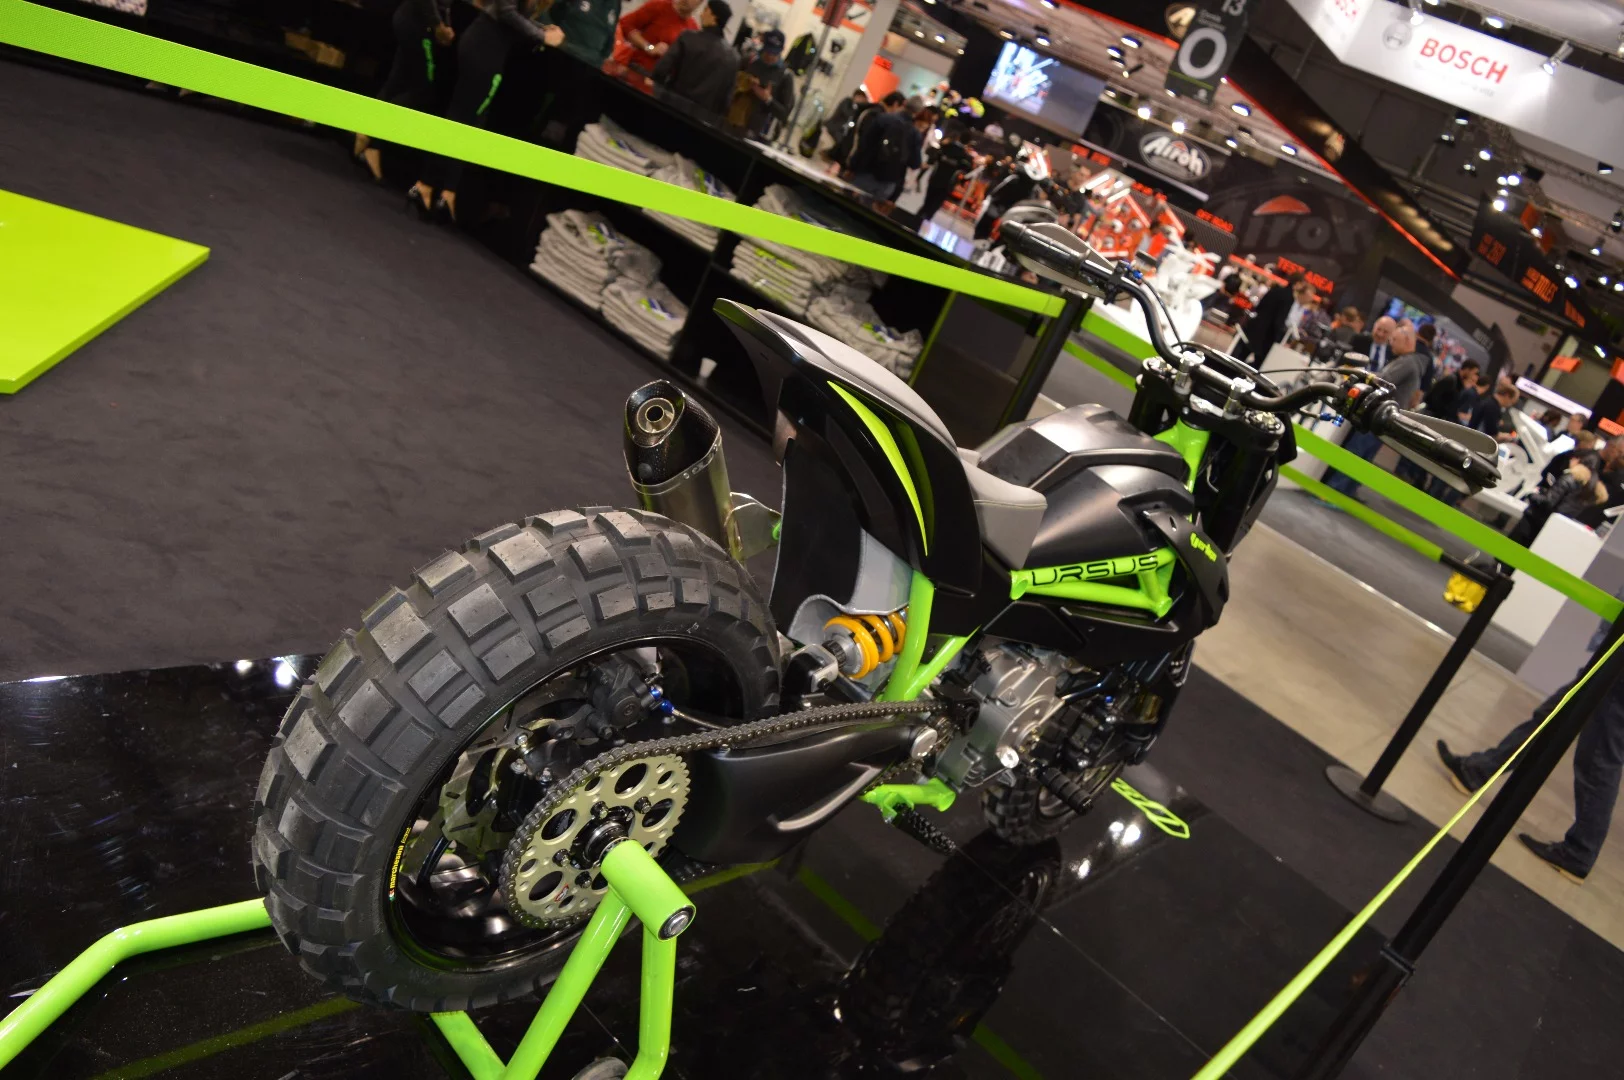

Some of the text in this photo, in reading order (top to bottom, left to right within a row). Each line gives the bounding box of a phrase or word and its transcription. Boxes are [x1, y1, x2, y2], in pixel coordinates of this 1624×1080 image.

[1419, 37, 1509, 85] BOSCH
[1143, 135, 1203, 177] Airoh
[1211, 215, 1234, 233] ROAD
[1277, 256, 1334, 294] TEST AREA
[1032, 555, 1158, 586] URSUS
